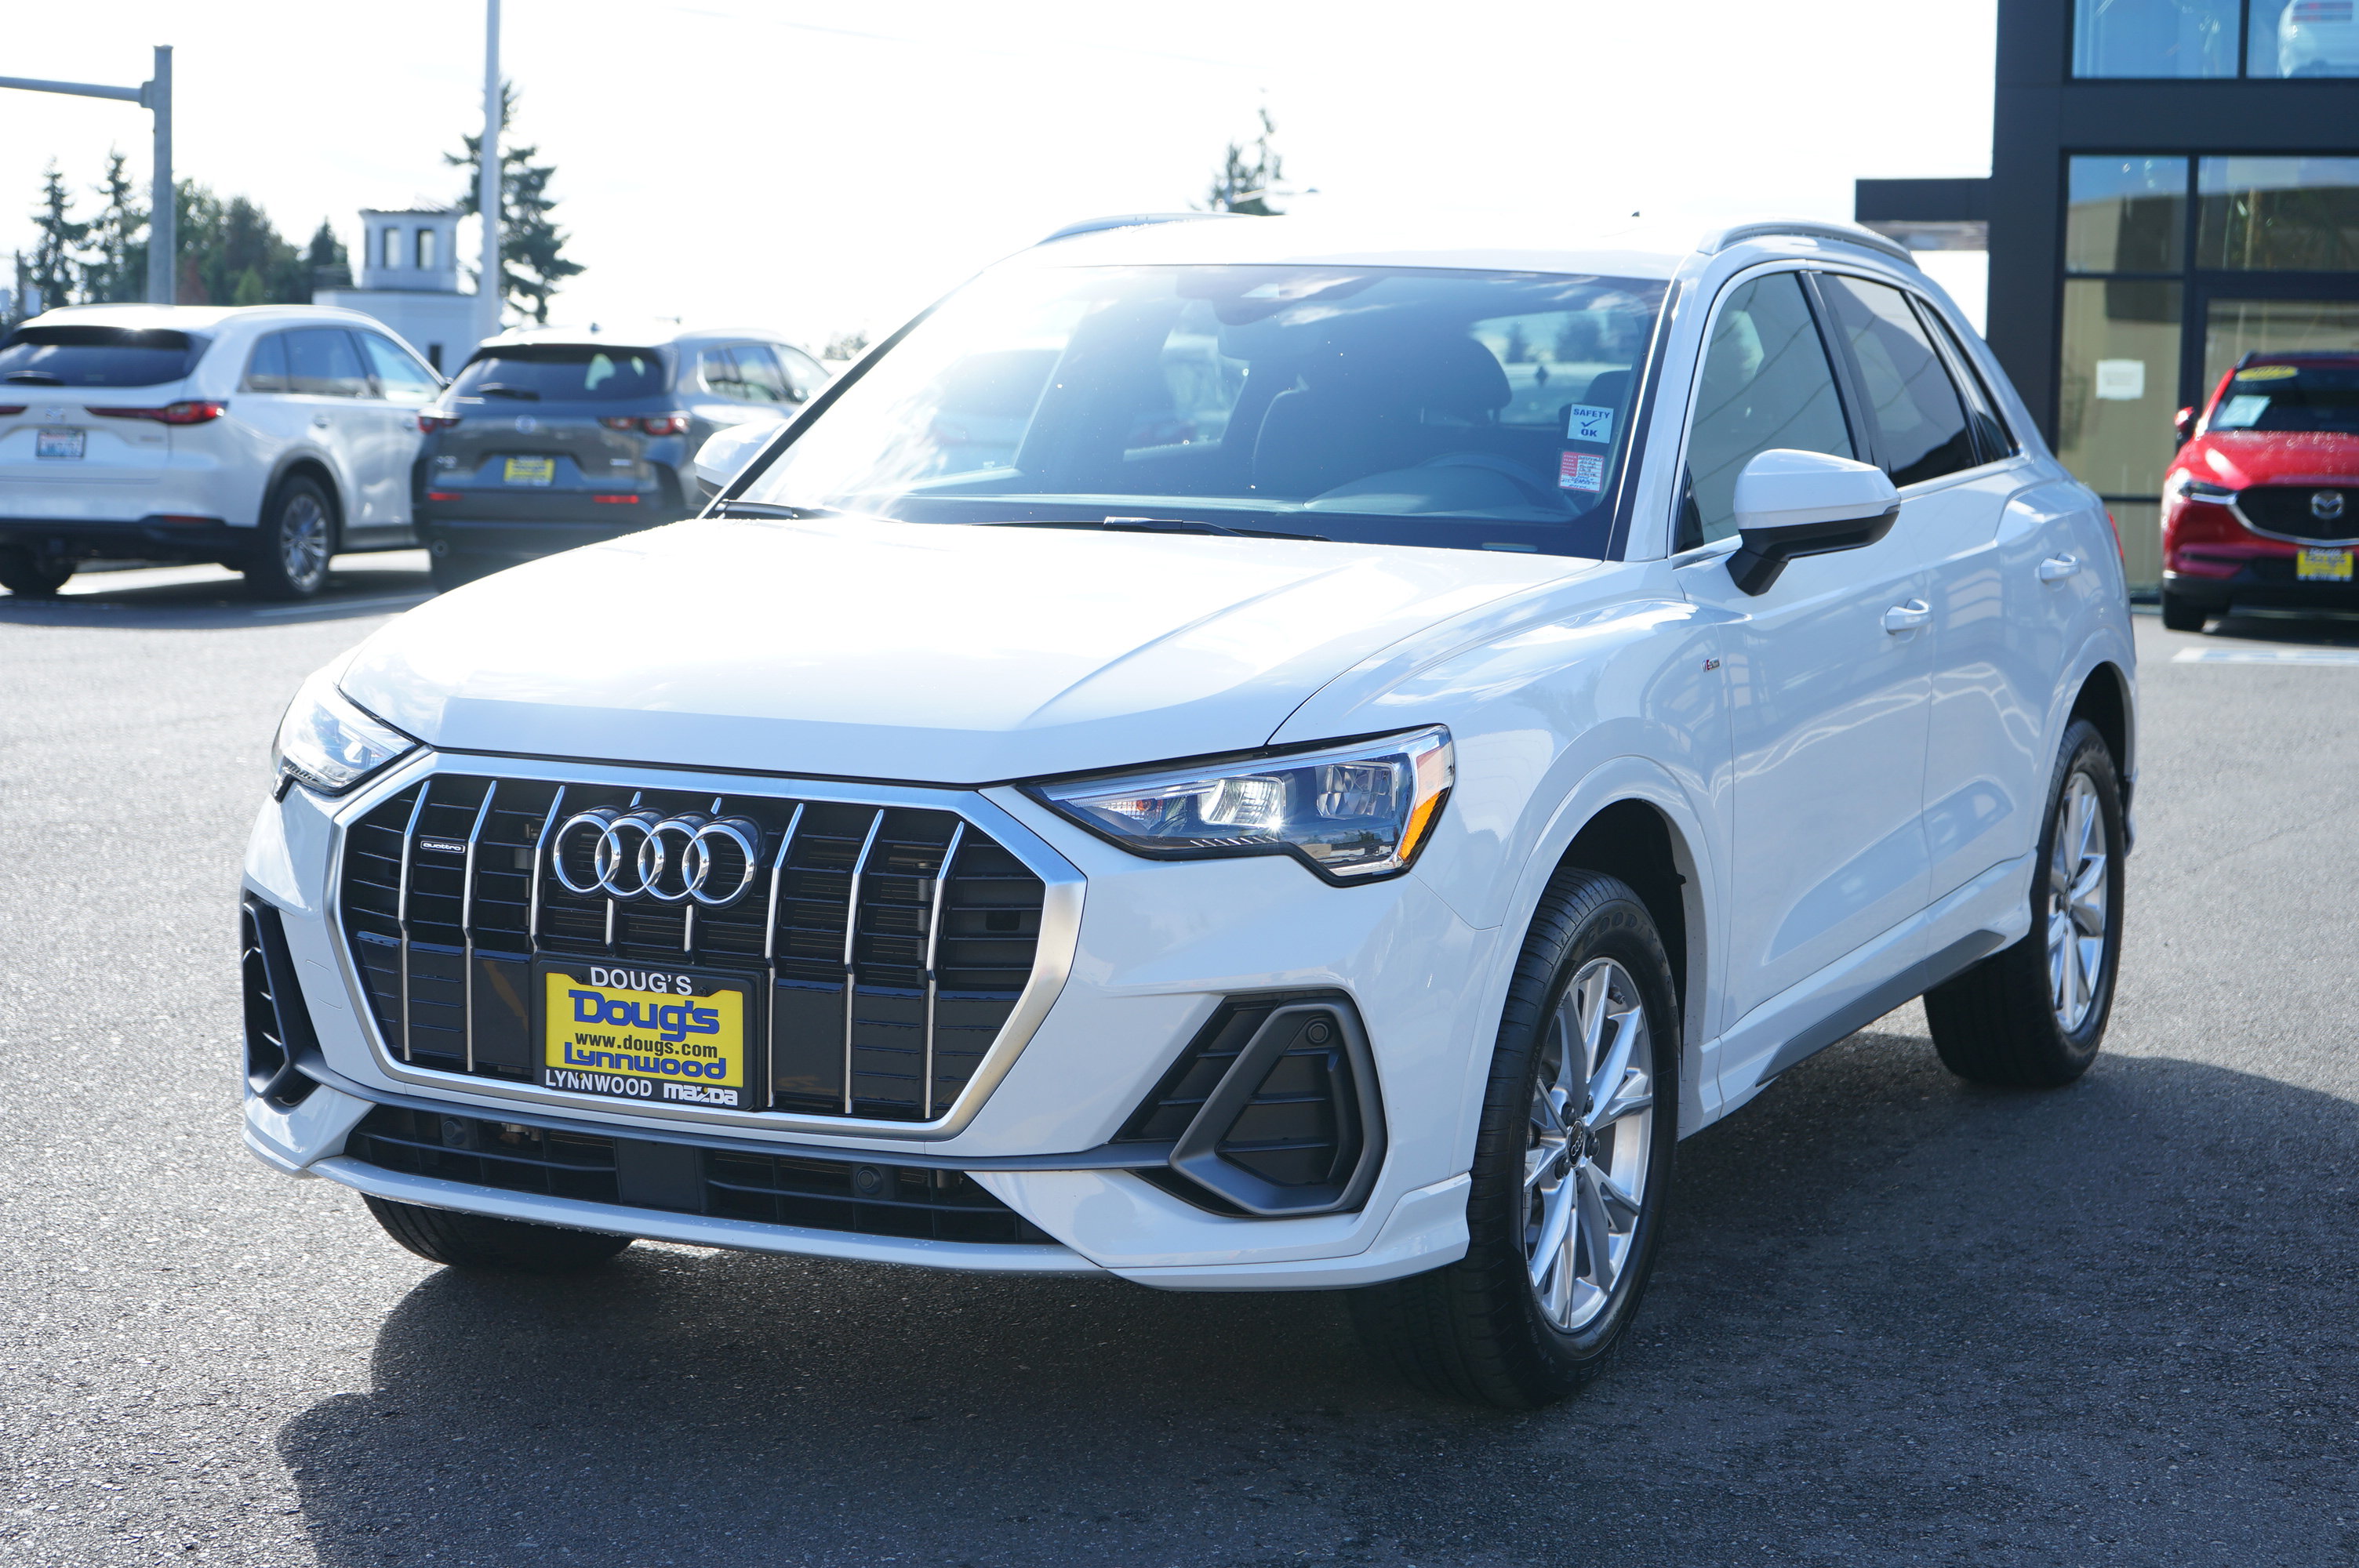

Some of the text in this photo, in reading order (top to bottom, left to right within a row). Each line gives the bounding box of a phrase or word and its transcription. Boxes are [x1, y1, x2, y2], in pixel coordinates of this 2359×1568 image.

[1573, 408, 1610, 419] SAFETY
[1581, 429, 1598, 437] OK
[591, 967, 692, 996] DOUG'S
[569, 989, 720, 1043] Doug's
[575, 1033, 718, 1058] www.dougs.com
[565, 1042, 726, 1080] Lynnwood
[545, 1069, 652, 1097] LYNNWOOD
